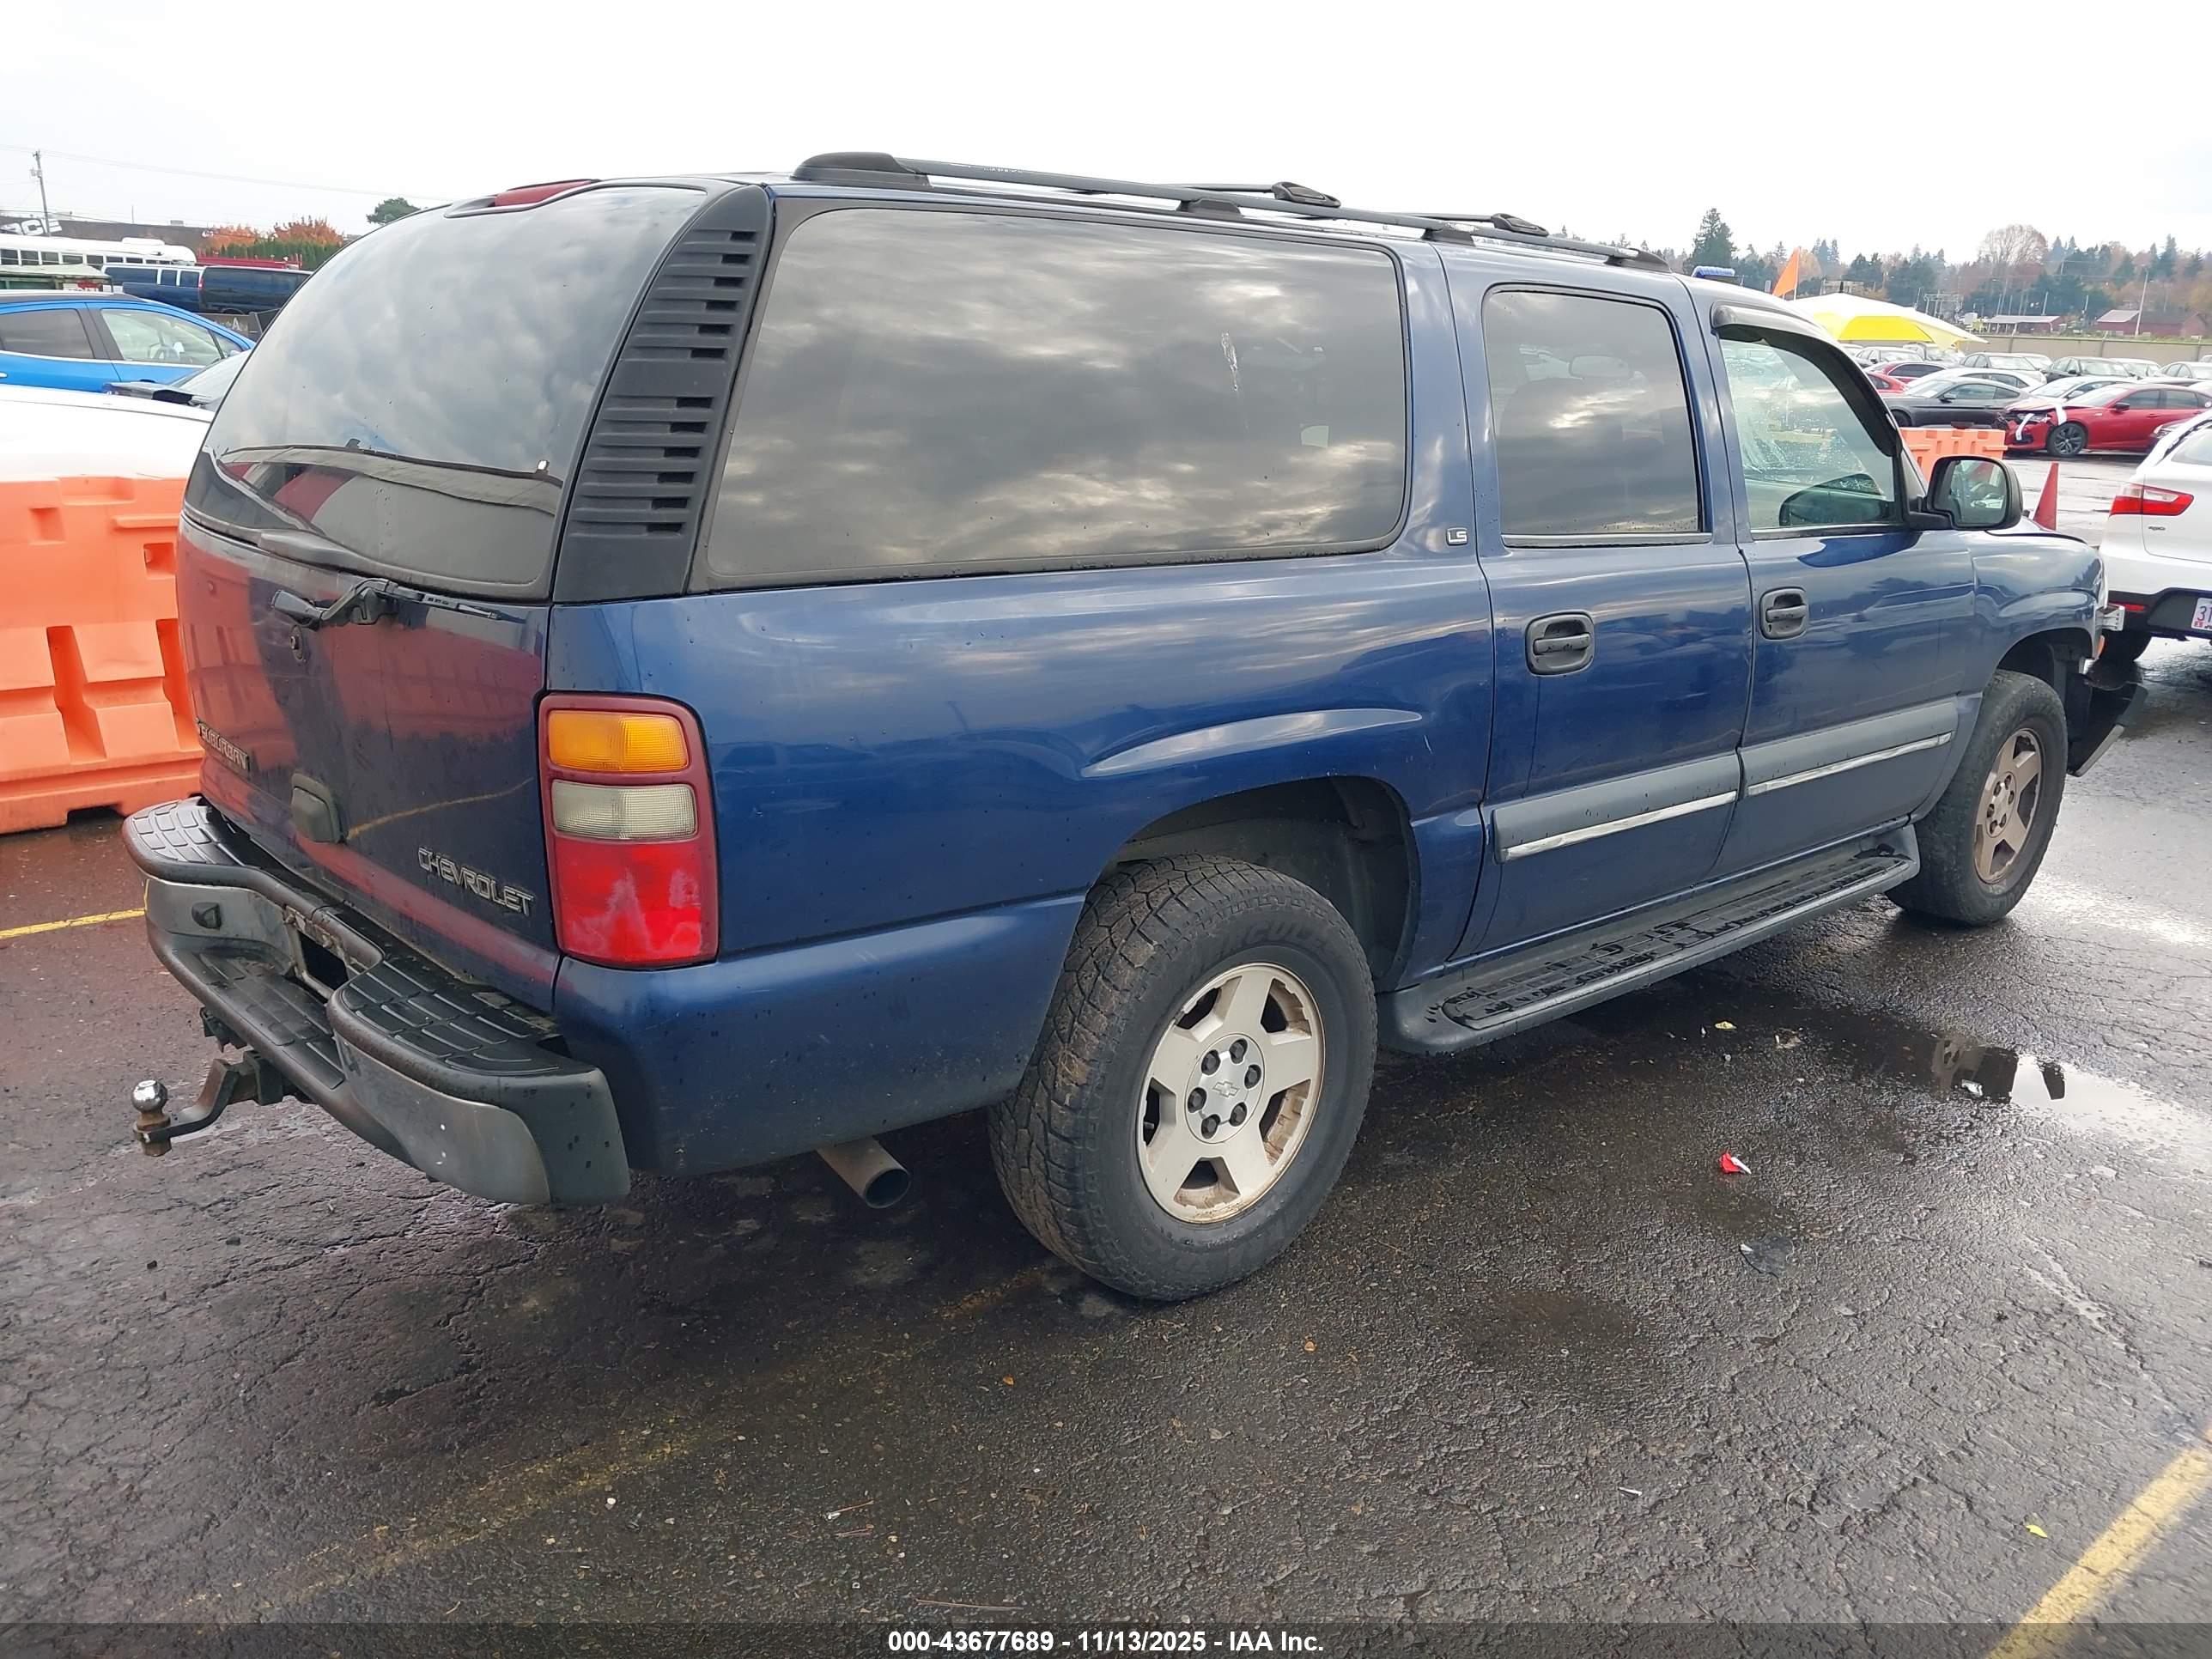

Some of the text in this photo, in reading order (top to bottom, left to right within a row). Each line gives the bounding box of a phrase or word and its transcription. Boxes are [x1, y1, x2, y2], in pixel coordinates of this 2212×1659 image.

[1448, 531, 1467, 542] LS
[198, 723, 247, 770] SUBURBAN
[418, 847, 534, 916] CHEVROLET
